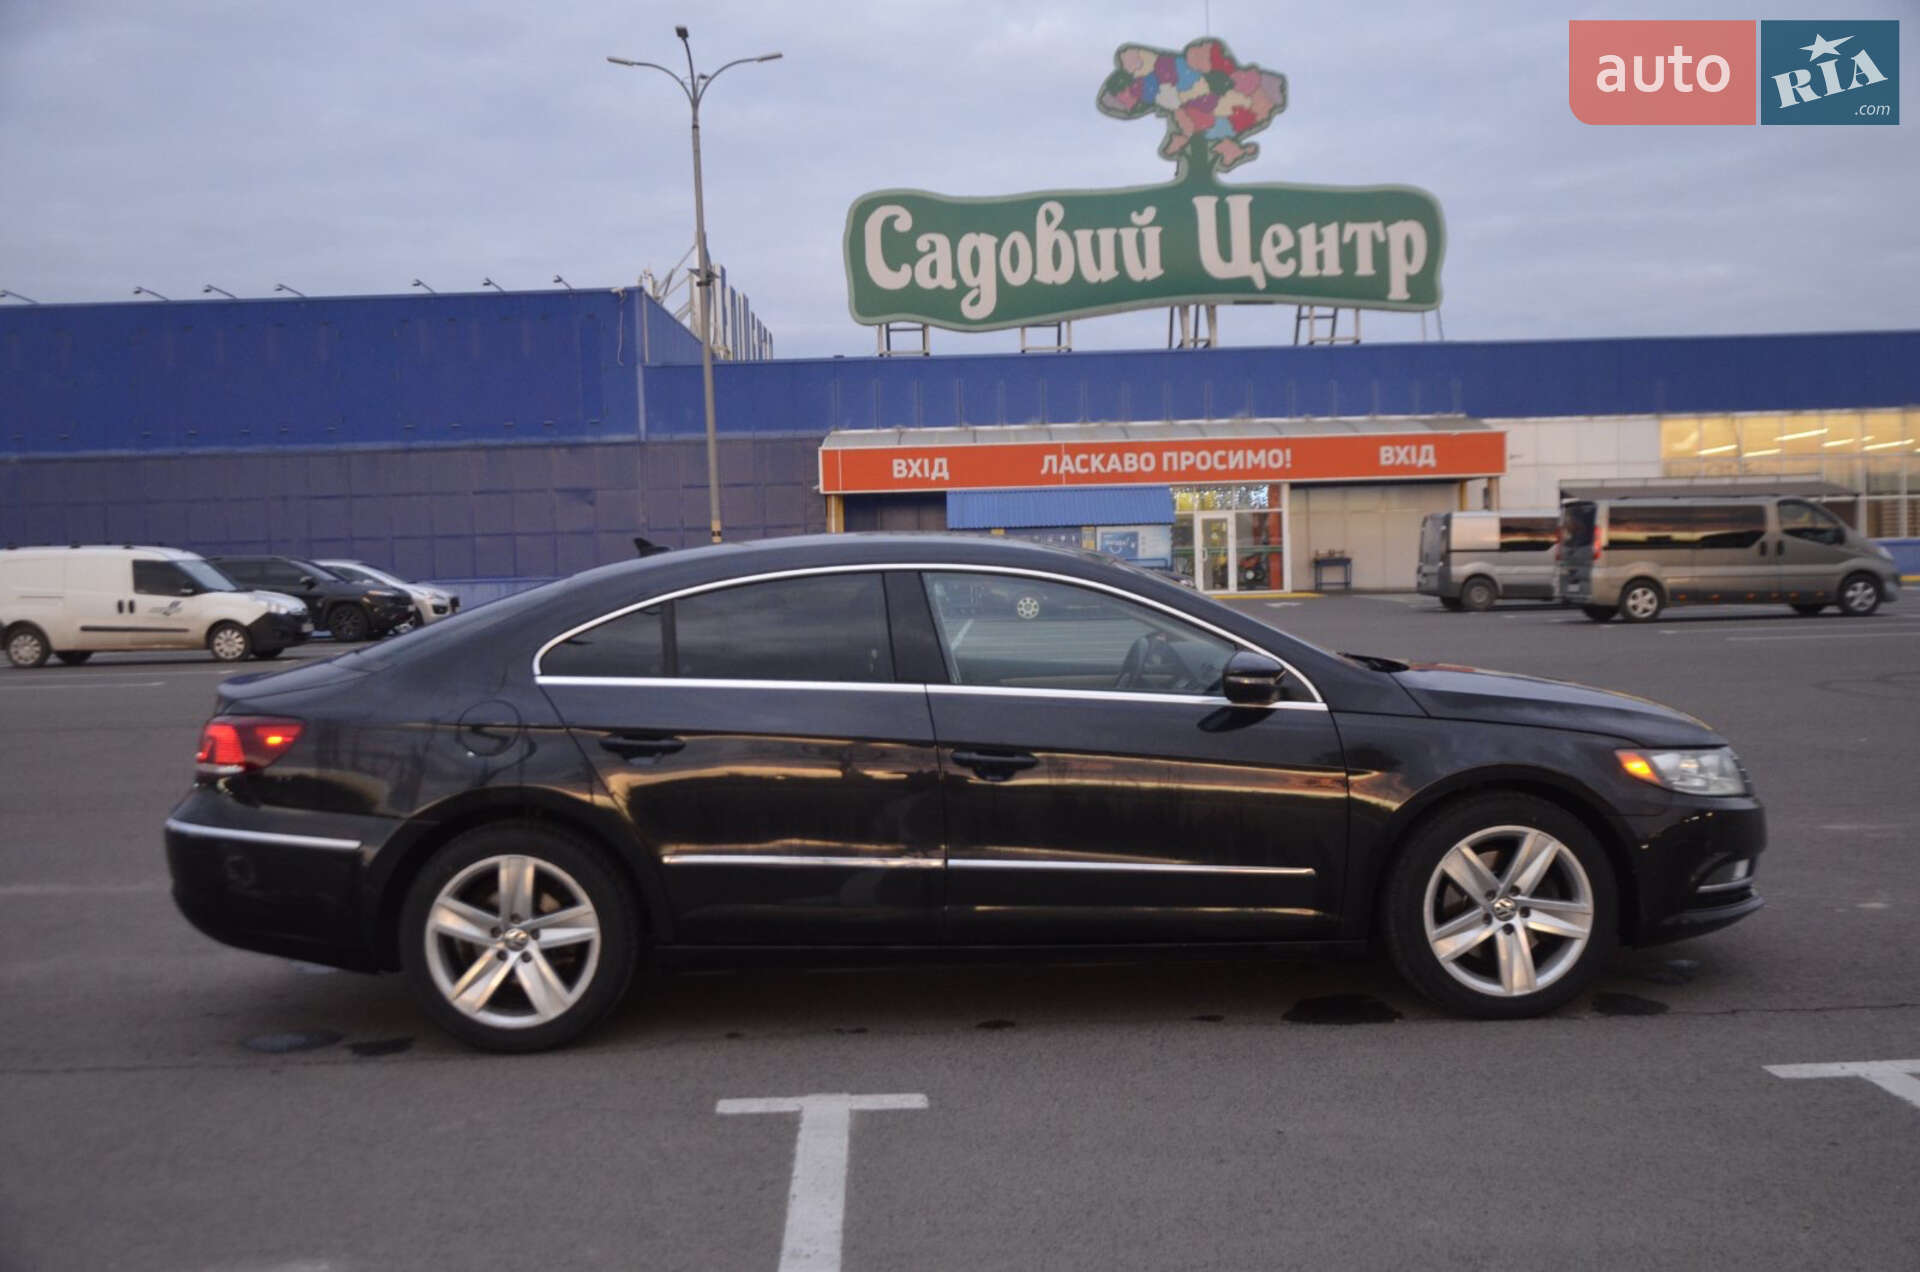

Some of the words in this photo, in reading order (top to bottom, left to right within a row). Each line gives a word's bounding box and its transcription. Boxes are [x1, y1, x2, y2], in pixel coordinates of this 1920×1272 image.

[864, 201, 1164, 320] Садовий
[1192, 194, 1428, 300] Центр
[892, 457, 949, 480] ВХІД
[1041, 452, 1156, 475] ЛАСКАВО
[1163, 448, 1292, 471] ПРОСИМО!
[1379, 444, 1437, 468] ВХІД
